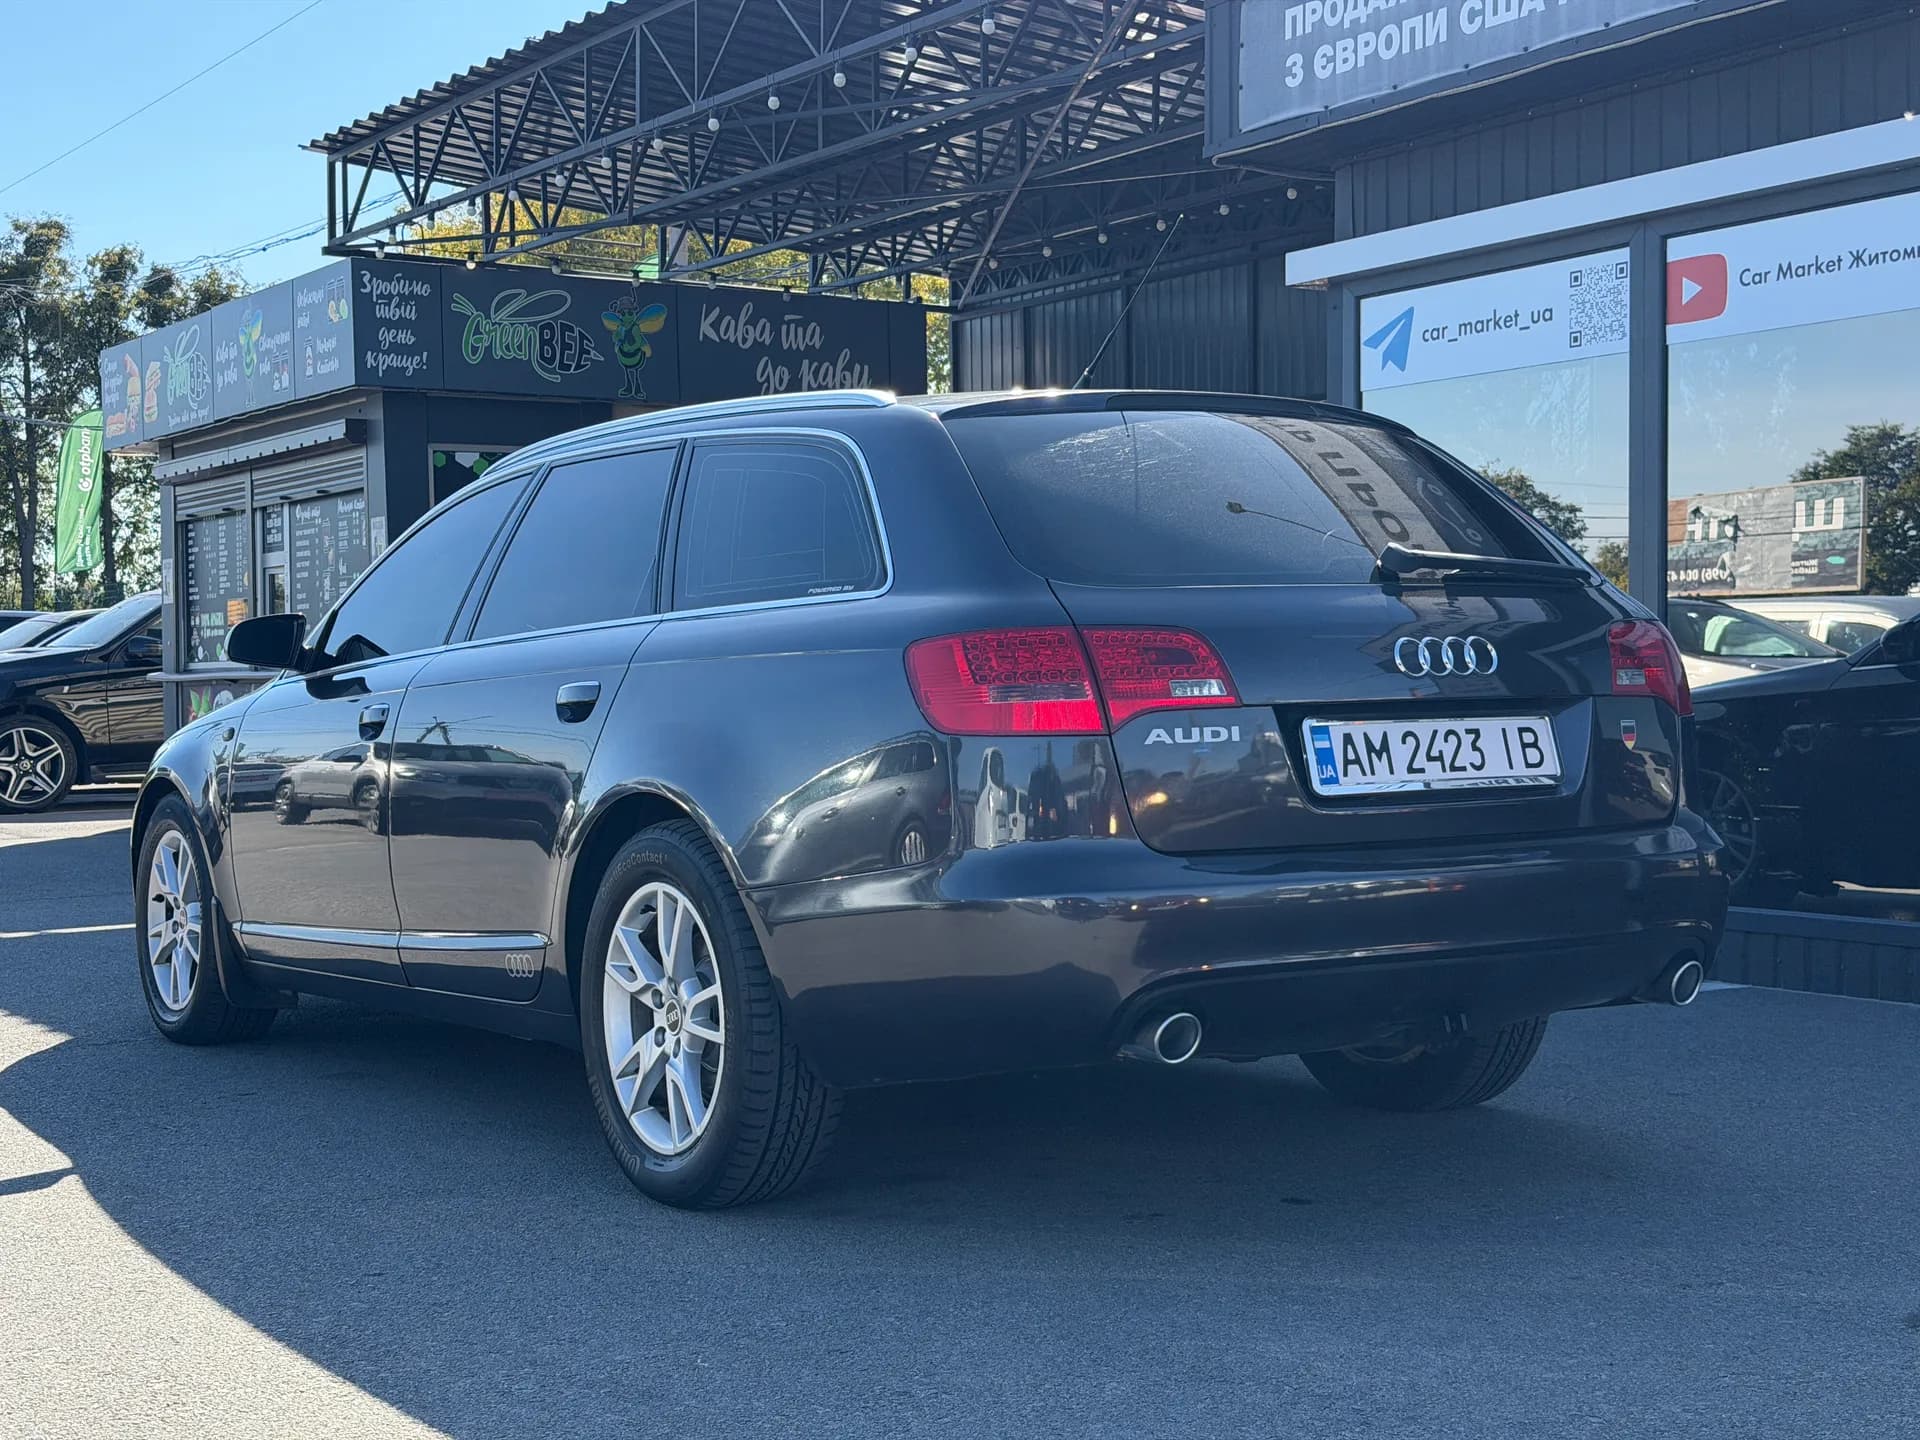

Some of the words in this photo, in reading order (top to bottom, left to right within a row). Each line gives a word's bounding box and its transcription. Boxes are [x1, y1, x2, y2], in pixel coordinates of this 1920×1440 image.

[1285, 0, 1406, 41] ПРОД
[1285, 52, 1304, 88] З
[1313, 6, 1448, 80] ЄВРОПИ
[1739, 268, 1772, 287] Car
[1776, 255, 1843, 282] Market
[1848, 246, 1920, 270] Житом
[360, 270, 432, 302] Зробимо
[376, 296, 418, 320] твій
[699, 302, 775, 350] Кава
[781, 314, 824, 351] та
[1422, 307, 1553, 342] car_market_ua
[379, 326, 416, 350] день
[365, 350, 428, 377] краще!
[756, 356, 791, 395] до
[798, 348, 872, 392] кави
[79, 427, 94, 475] otpban
[1144, 726, 1240, 745] AUDI
[1342, 731, 1394, 778] AM
[1401, 728, 1486, 774] 2423
[1501, 726, 1545, 770] IB
[1317, 764, 1337, 779] UA
